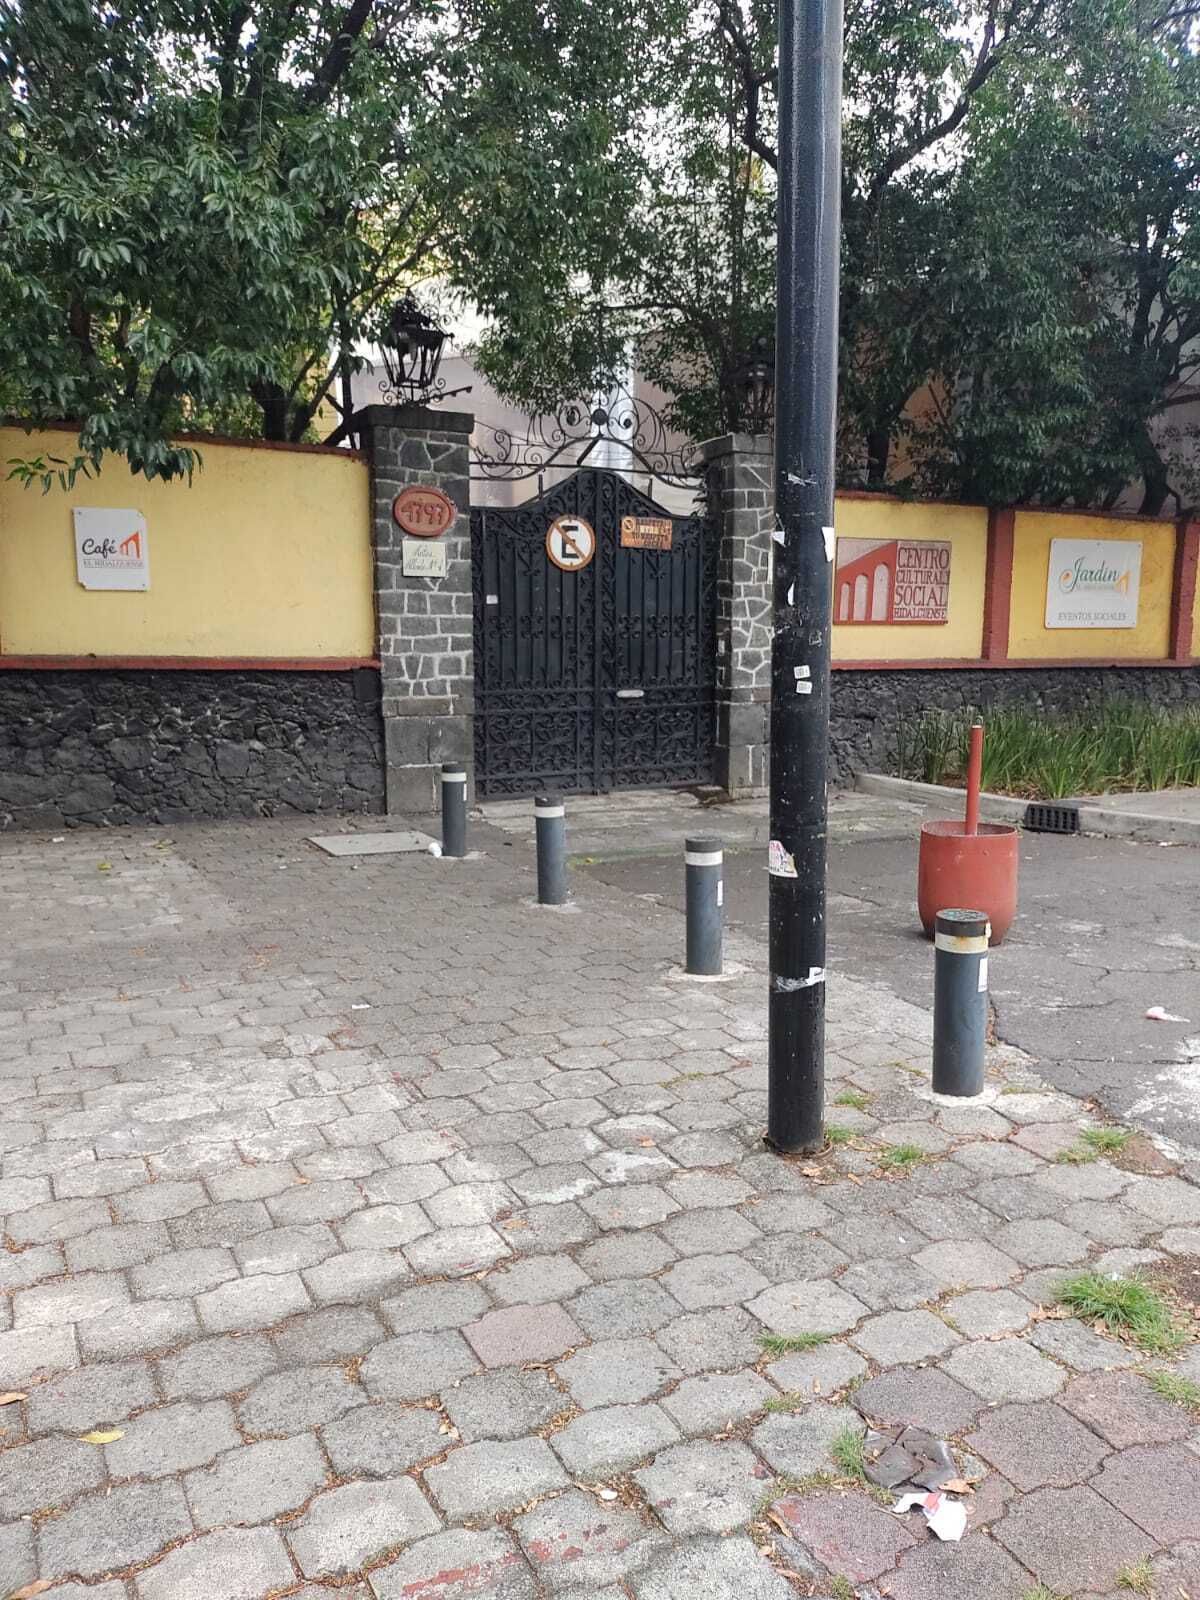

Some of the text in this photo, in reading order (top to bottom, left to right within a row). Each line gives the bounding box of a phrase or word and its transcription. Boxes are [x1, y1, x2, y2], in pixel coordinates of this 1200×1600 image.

[82, 538, 117, 559] Café
[898, 546, 949, 569] CENTRO
[896, 569, 945, 585] CULTURAL
[895, 585, 947, 606] SOCIAL
[894, 607, 946, 619] HIDALGUENSE
